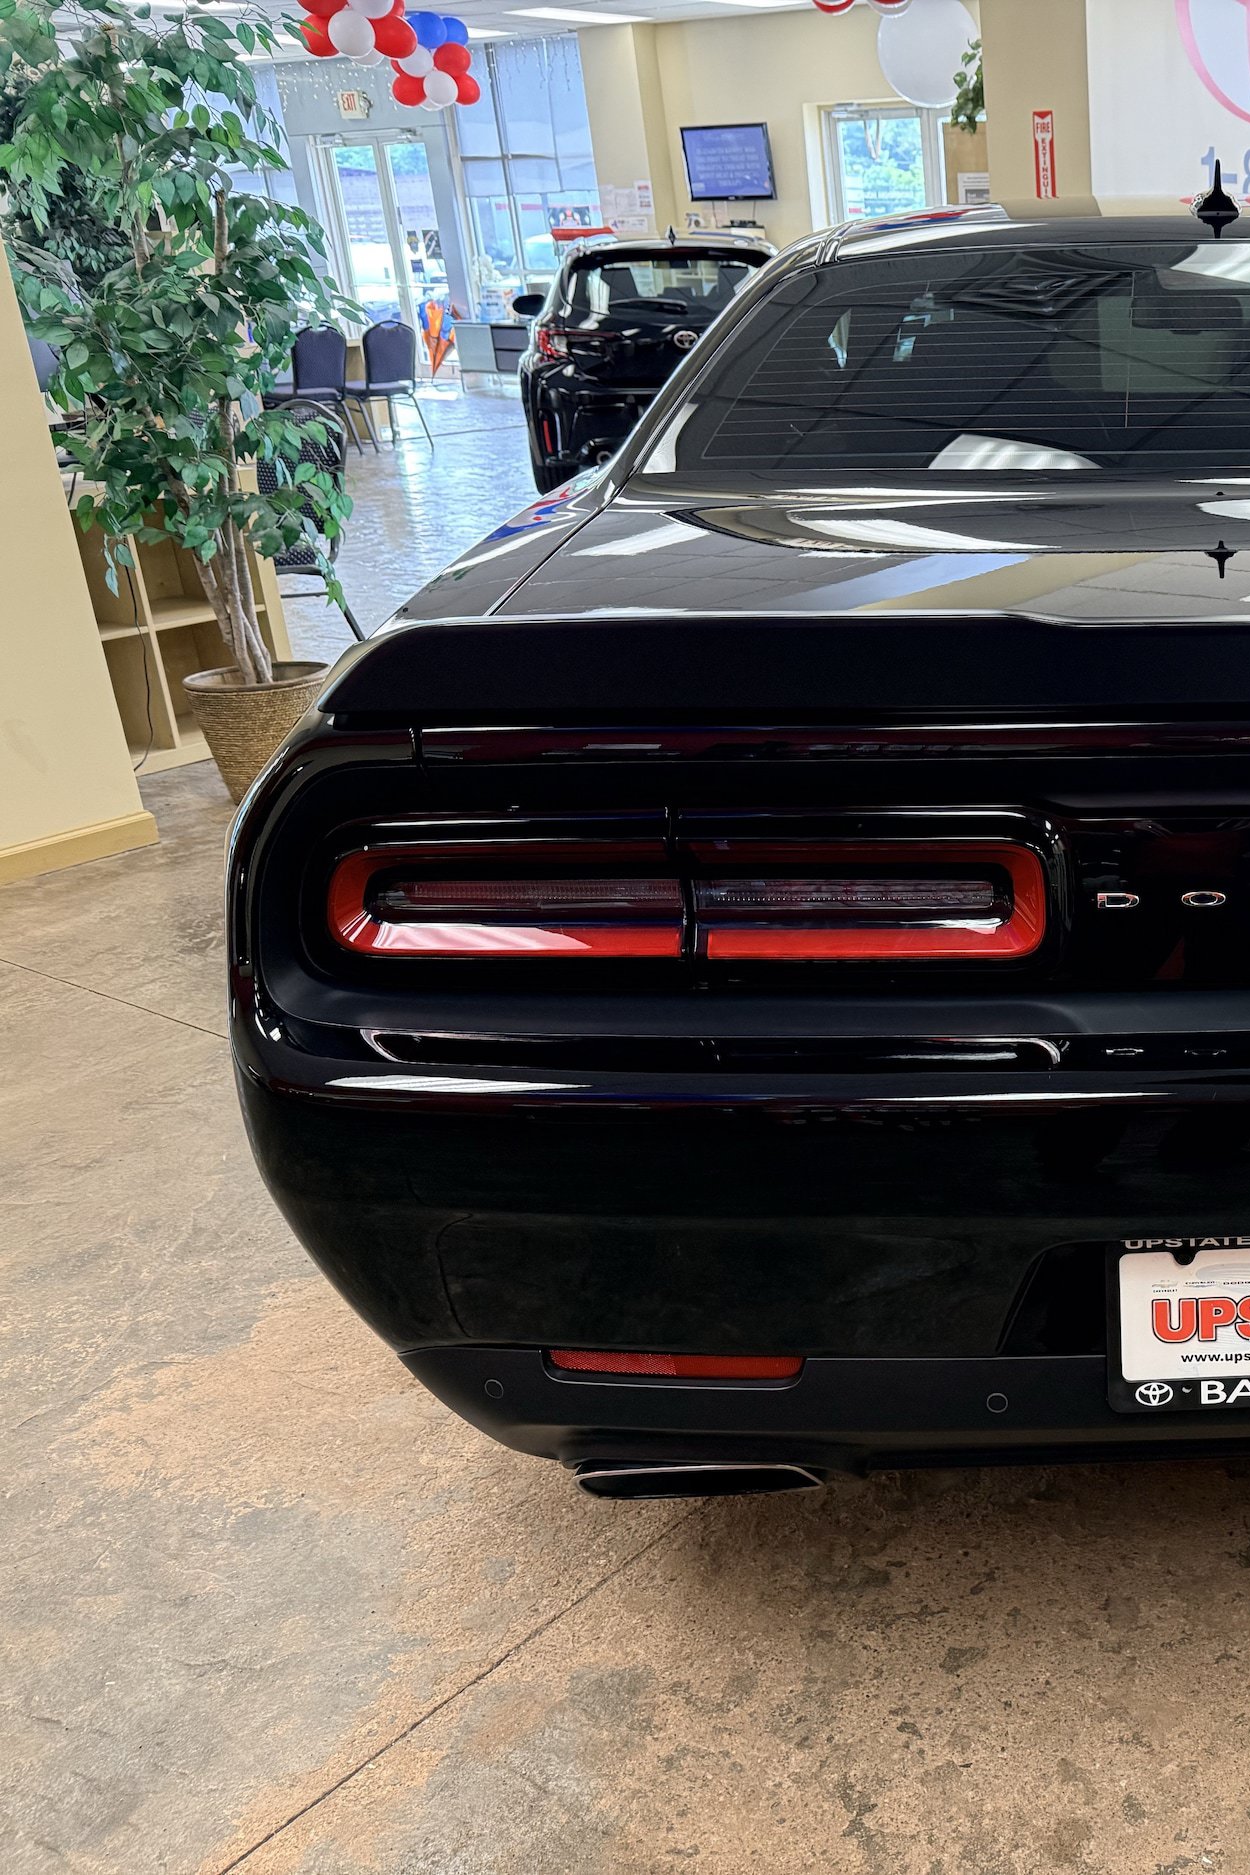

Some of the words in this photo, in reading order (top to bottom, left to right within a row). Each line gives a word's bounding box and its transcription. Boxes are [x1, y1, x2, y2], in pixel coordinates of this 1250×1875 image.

[341, 93, 357, 111] EXIT
[1036, 122, 1050, 133] FIRE
[1041, 138, 1049, 198] EXTINGUI
